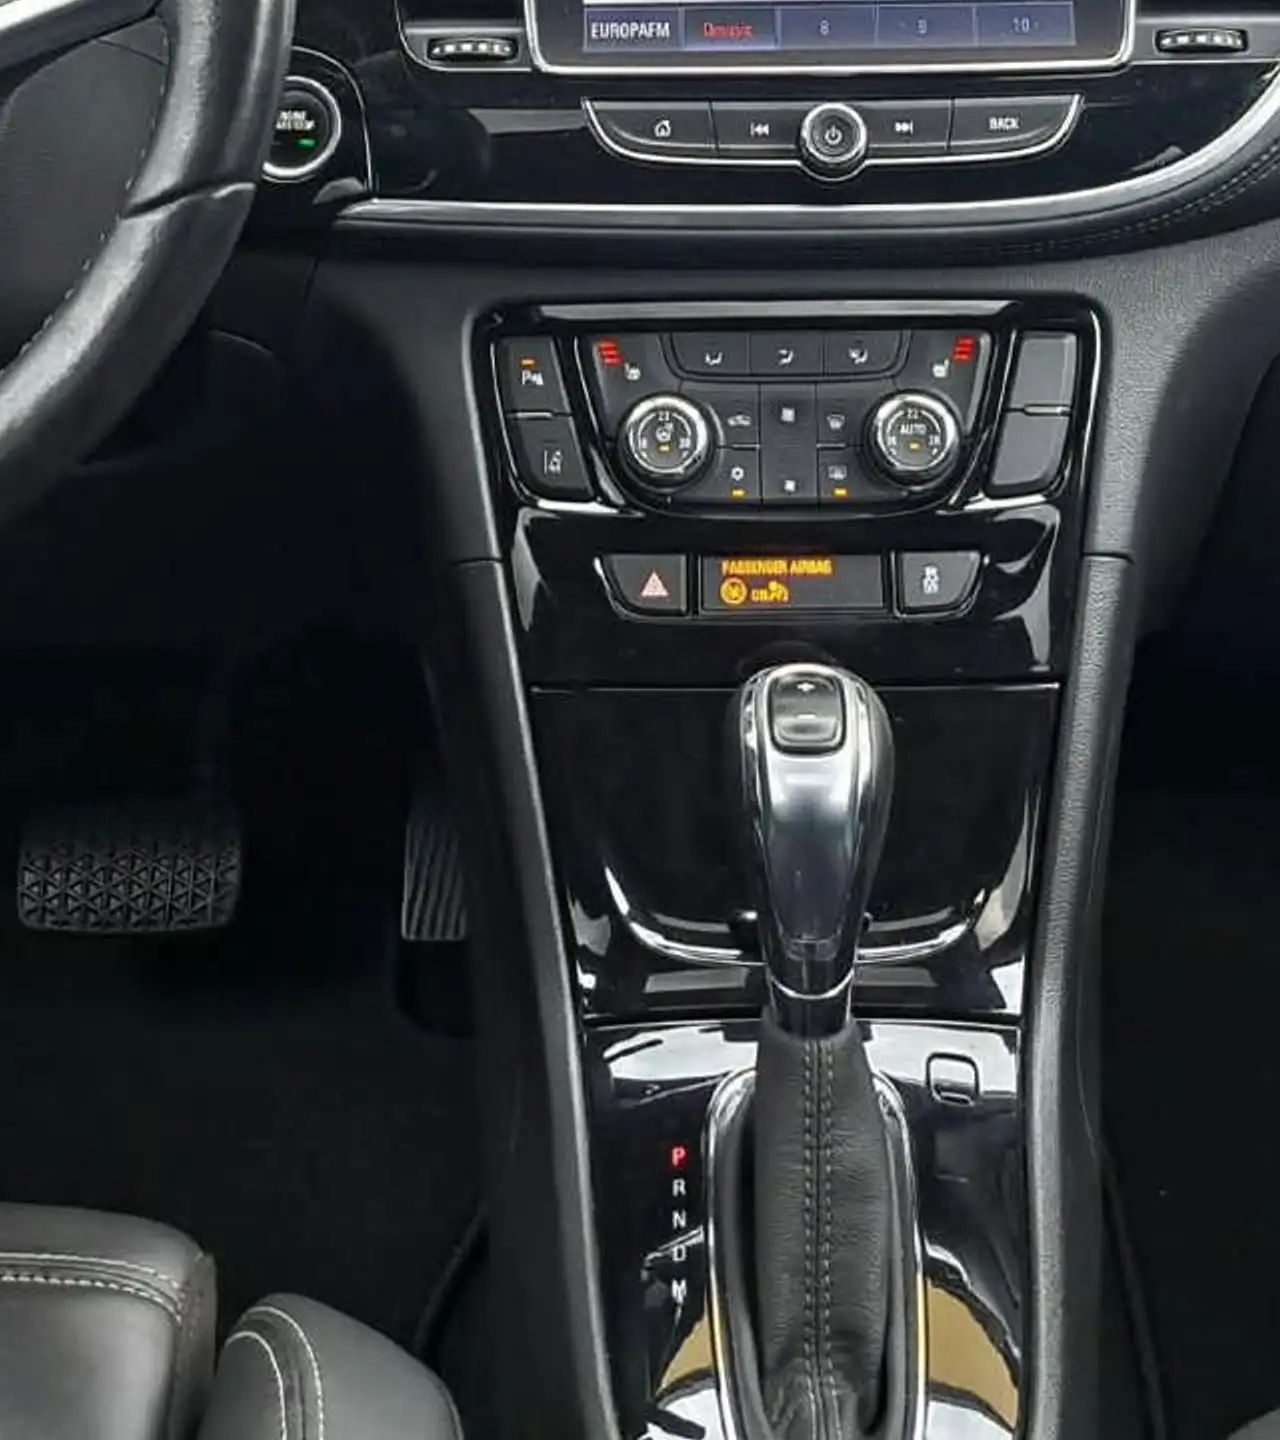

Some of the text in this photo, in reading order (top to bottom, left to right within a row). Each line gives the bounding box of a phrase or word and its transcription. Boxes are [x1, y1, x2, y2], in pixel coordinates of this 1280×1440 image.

[988, 115, 1021, 130] BACK
[900, 423, 928, 437] AUTO
[671, 1146, 686, 1167] P
[671, 1178, 687, 1197] R
[671, 1210, 687, 1229] N
[671, 1245, 687, 1263] D
[671, 1278, 688, 1300] M
